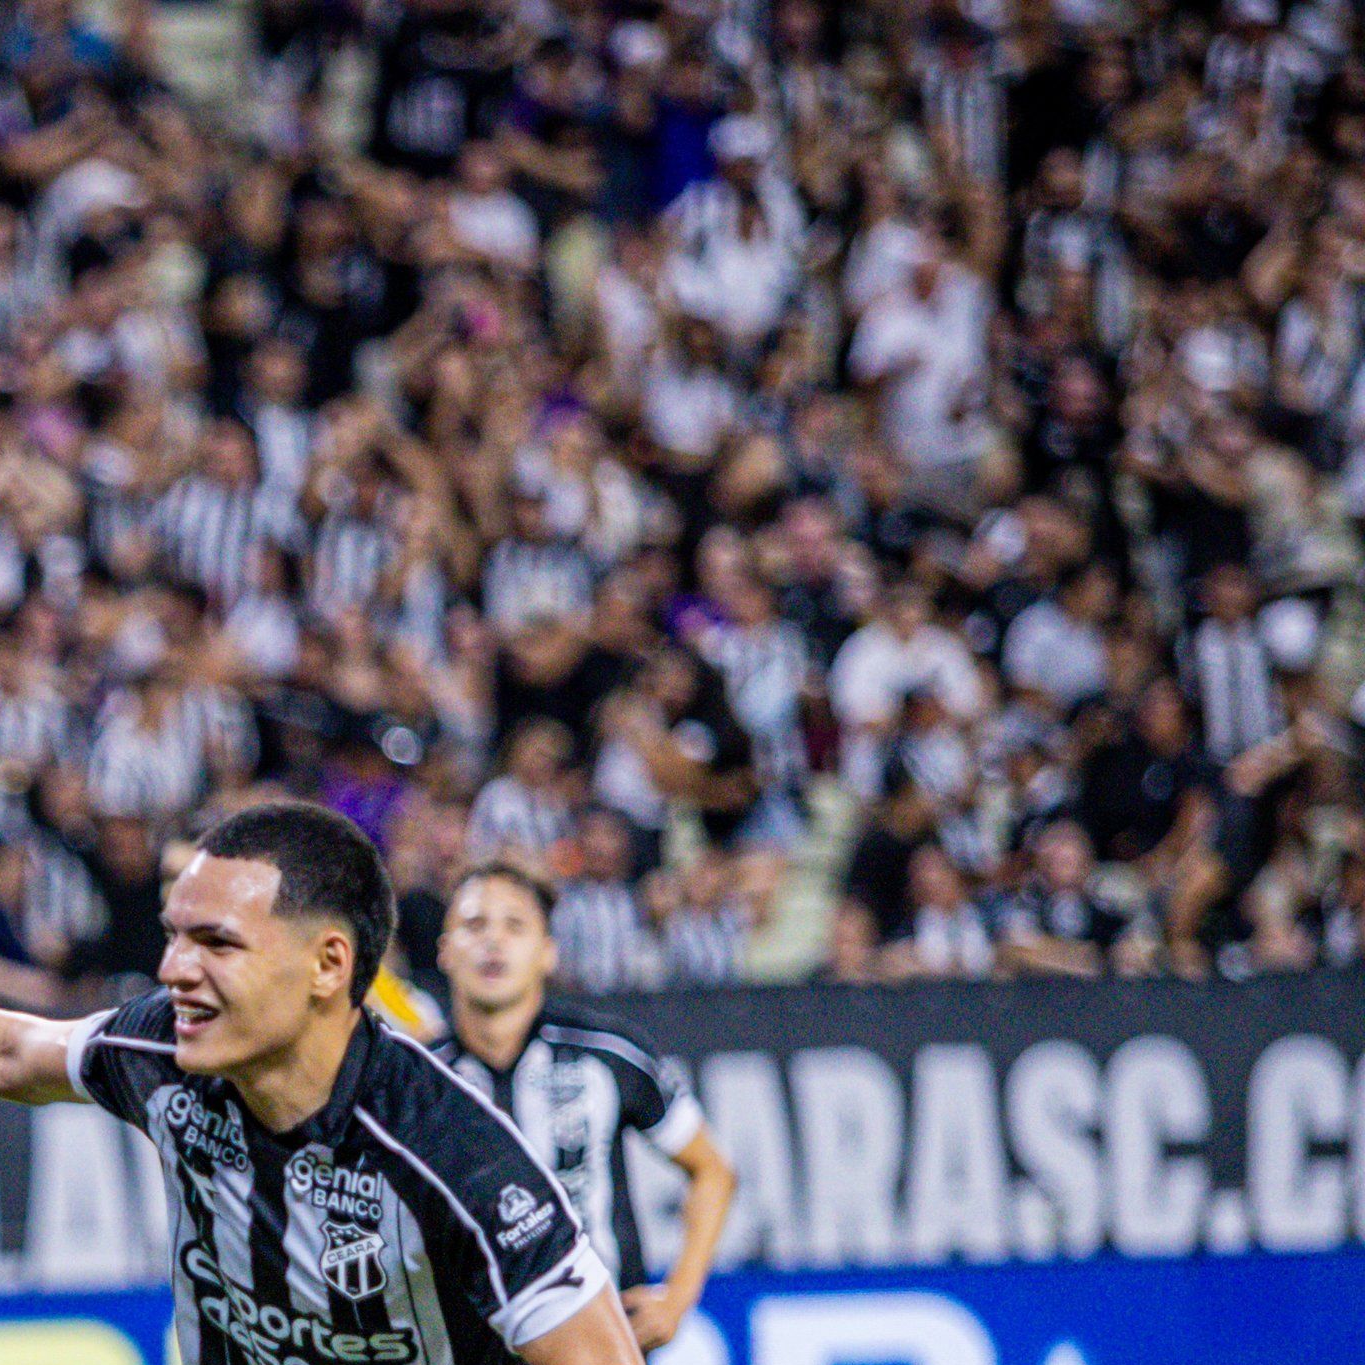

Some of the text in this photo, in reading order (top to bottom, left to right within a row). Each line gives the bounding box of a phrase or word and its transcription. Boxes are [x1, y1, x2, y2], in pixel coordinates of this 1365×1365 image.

[166, 1089, 245, 1147] genia
[184, 1124, 248, 1170] BANCO
[622, 1033, 1365, 1275] ARASC.C
[313, 1188, 383, 1220] BANCO
